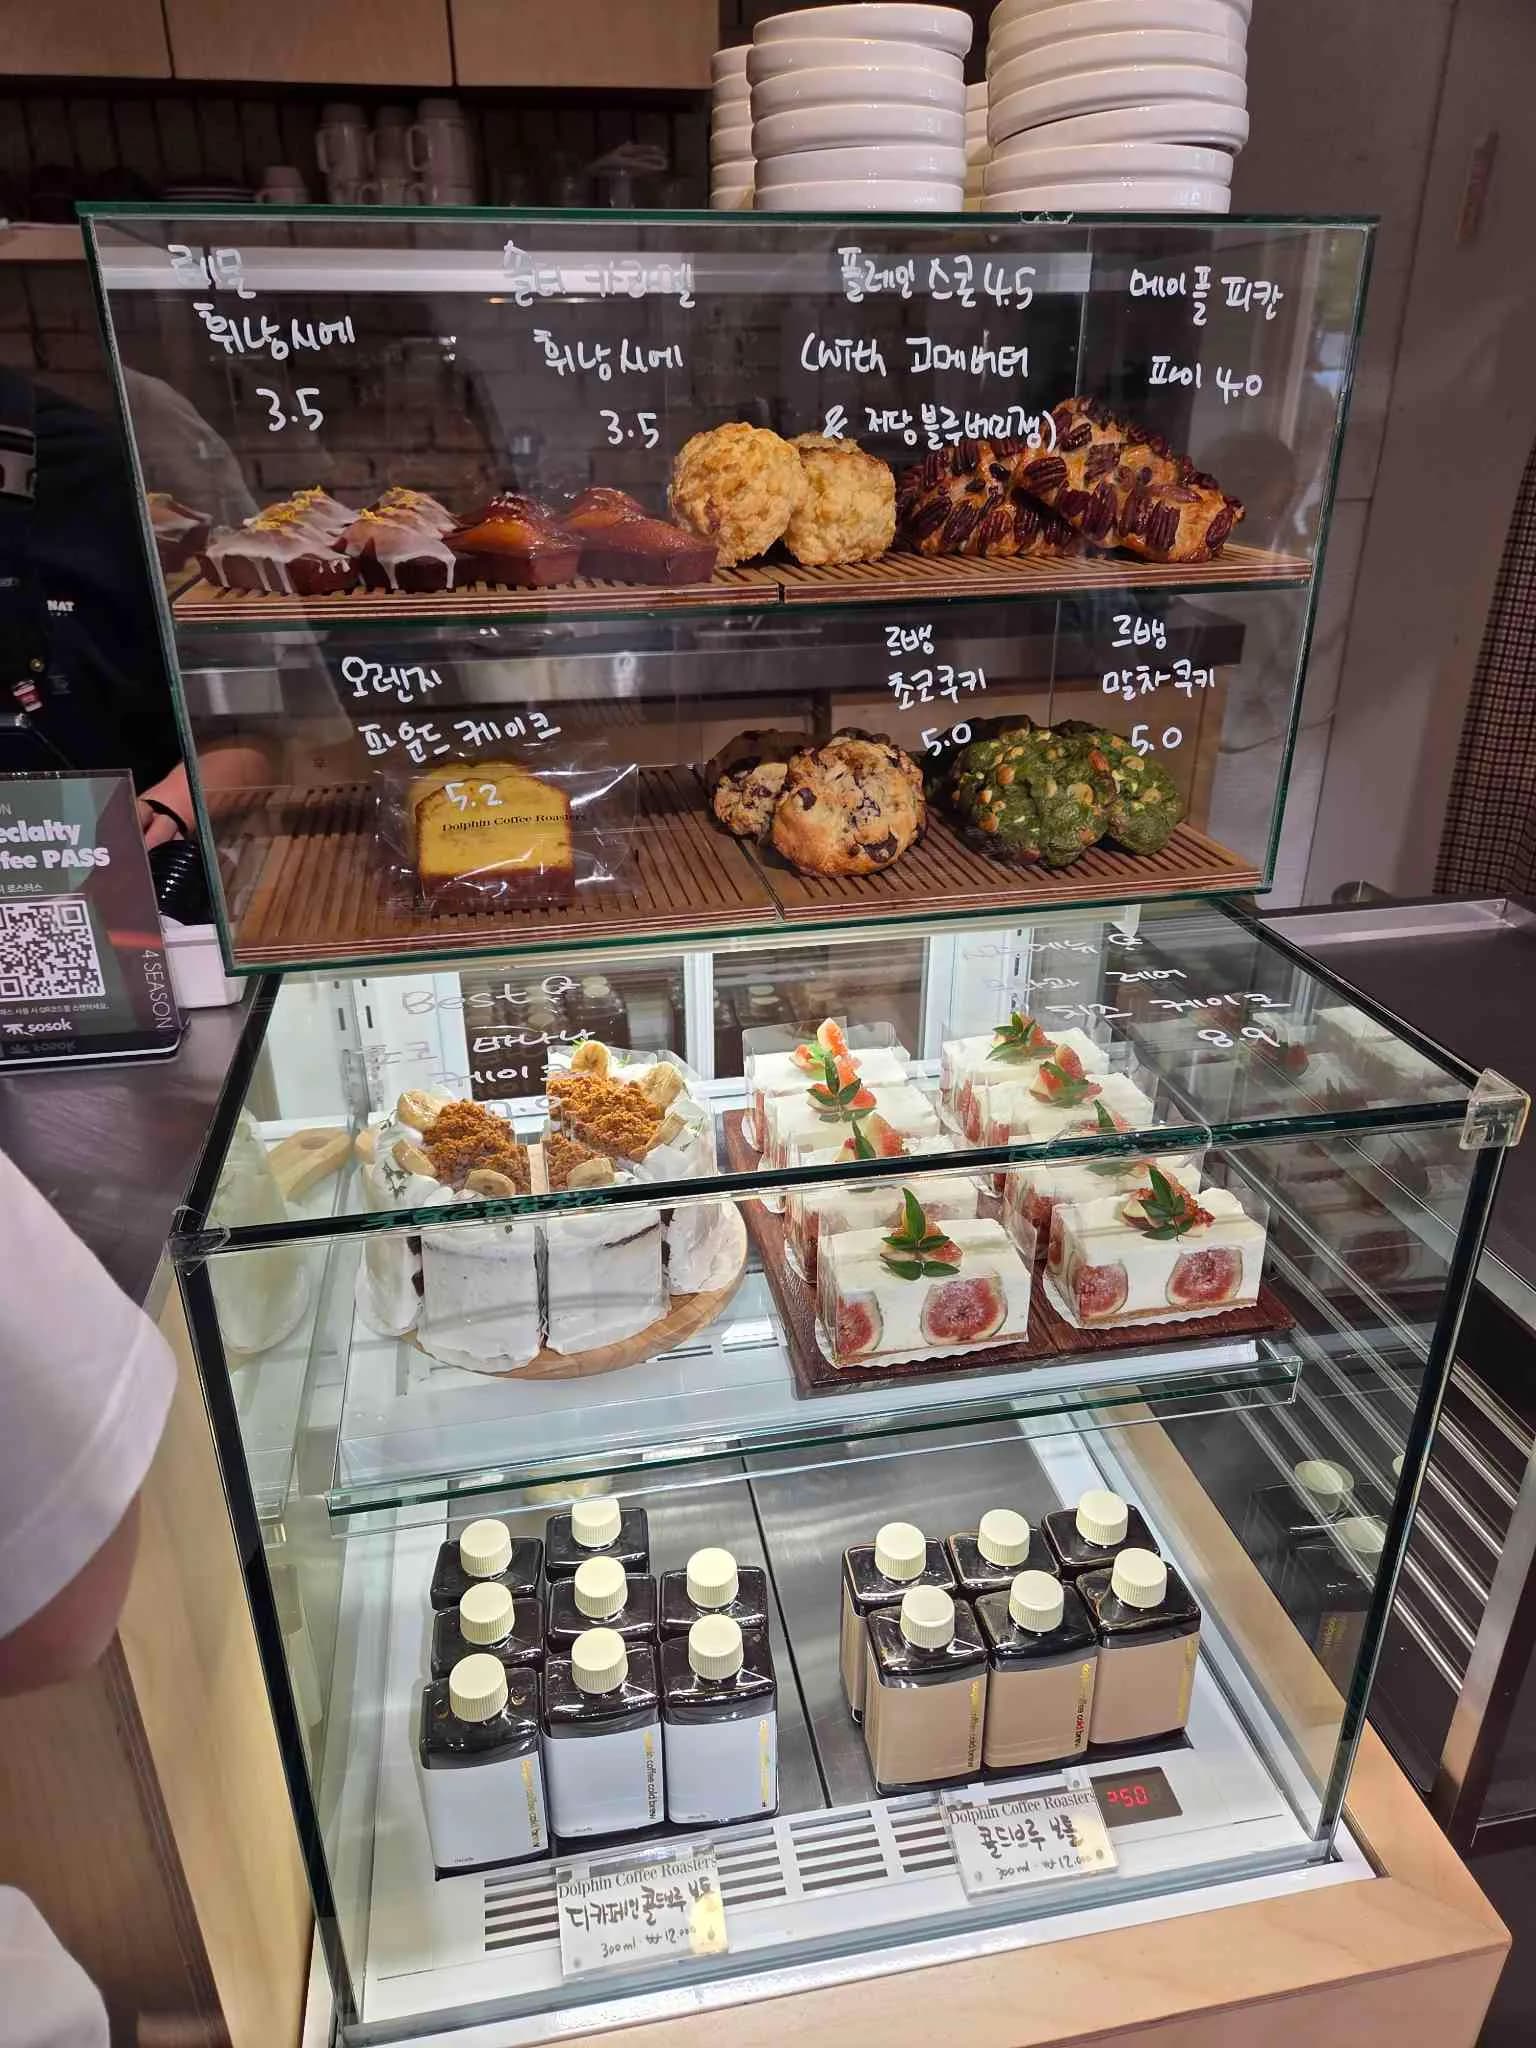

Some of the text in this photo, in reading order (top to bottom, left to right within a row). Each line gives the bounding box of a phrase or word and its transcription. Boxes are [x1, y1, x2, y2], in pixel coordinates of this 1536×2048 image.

[838, 247, 1036, 310] 플레인 스콘 4.5
[1129, 265, 1284, 326] 메이플 피칸
[193, 302, 355, 361] 휘낭시에
[533, 328, 683, 381] 휘낭시에
[801, 332, 1028, 378] (with 고메버터
[1149, 355, 1263, 405] 파이 4.0
[256, 387, 324, 431] 3.5
[599, 410, 660, 449] 3.5
[823, 404, 848, 440] &
[864, 407, 918, 446] 저당
[885, 624, 935, 656] 르뱅
[1112, 614, 1167, 650] 르뱅
[341, 656, 442, 703] 오렌지
[887, 664, 987, 710] 초코쿠키
[1102, 659, 1216, 700] 말차쿠키
[358, 712, 562, 763] 파운드 케이크
[921, 722, 973, 756] 5.0
[1131, 724, 1183, 756] 5.0
[445, 782, 503, 811] 5.2
[442, 820, 490, 832] Dolphin
[494, 816, 532, 826] Coffee
[42, 848, 110, 868] PASS
[143, 960, 174, 1030] SEASON
[27, 1018, 73, 1033] sosok
[1197, 1027, 1281, 1049] 8.9
[949, 1791, 1096, 1826] Dolphin Coffee Roasters
[977, 1819, 1046, 1859] 콜드브루
[558, 1855, 718, 1899] Dolphin Coffee Roasters
[565, 1897, 640, 1932] 디카페인
[641, 1885, 687, 1926] 콜드브루
